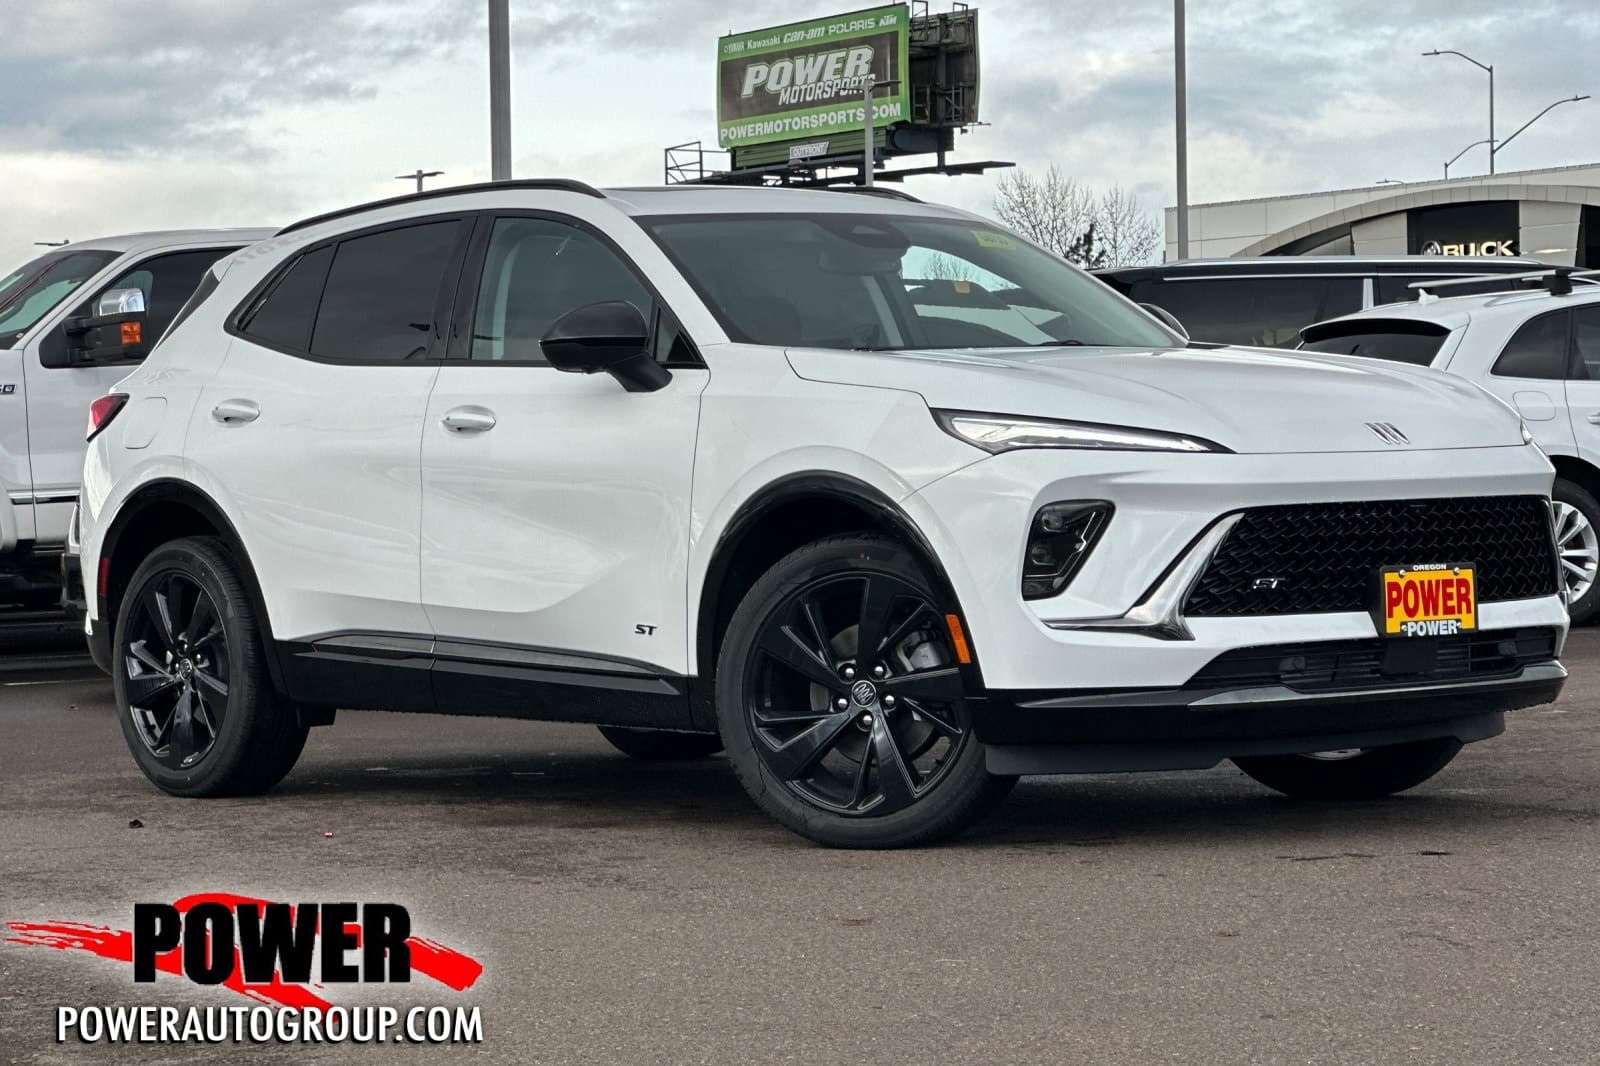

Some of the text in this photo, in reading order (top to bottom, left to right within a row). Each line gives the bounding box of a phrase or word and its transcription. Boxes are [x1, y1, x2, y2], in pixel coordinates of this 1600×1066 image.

[828, 17, 875, 36] POLARIS
[879, 15, 897, 27] KTM
[742, 45, 874, 97] POWER
[720, 102, 900, 141] POWERMOTORSPORTSCOM
[1443, 240, 1514, 256] BUICK
[1412, 563, 1447, 571] OREGON
[1386, 578, 1472, 619] POWER
[634, 623, 657, 636] ST
[1407, 619, 1458, 637] POWER
